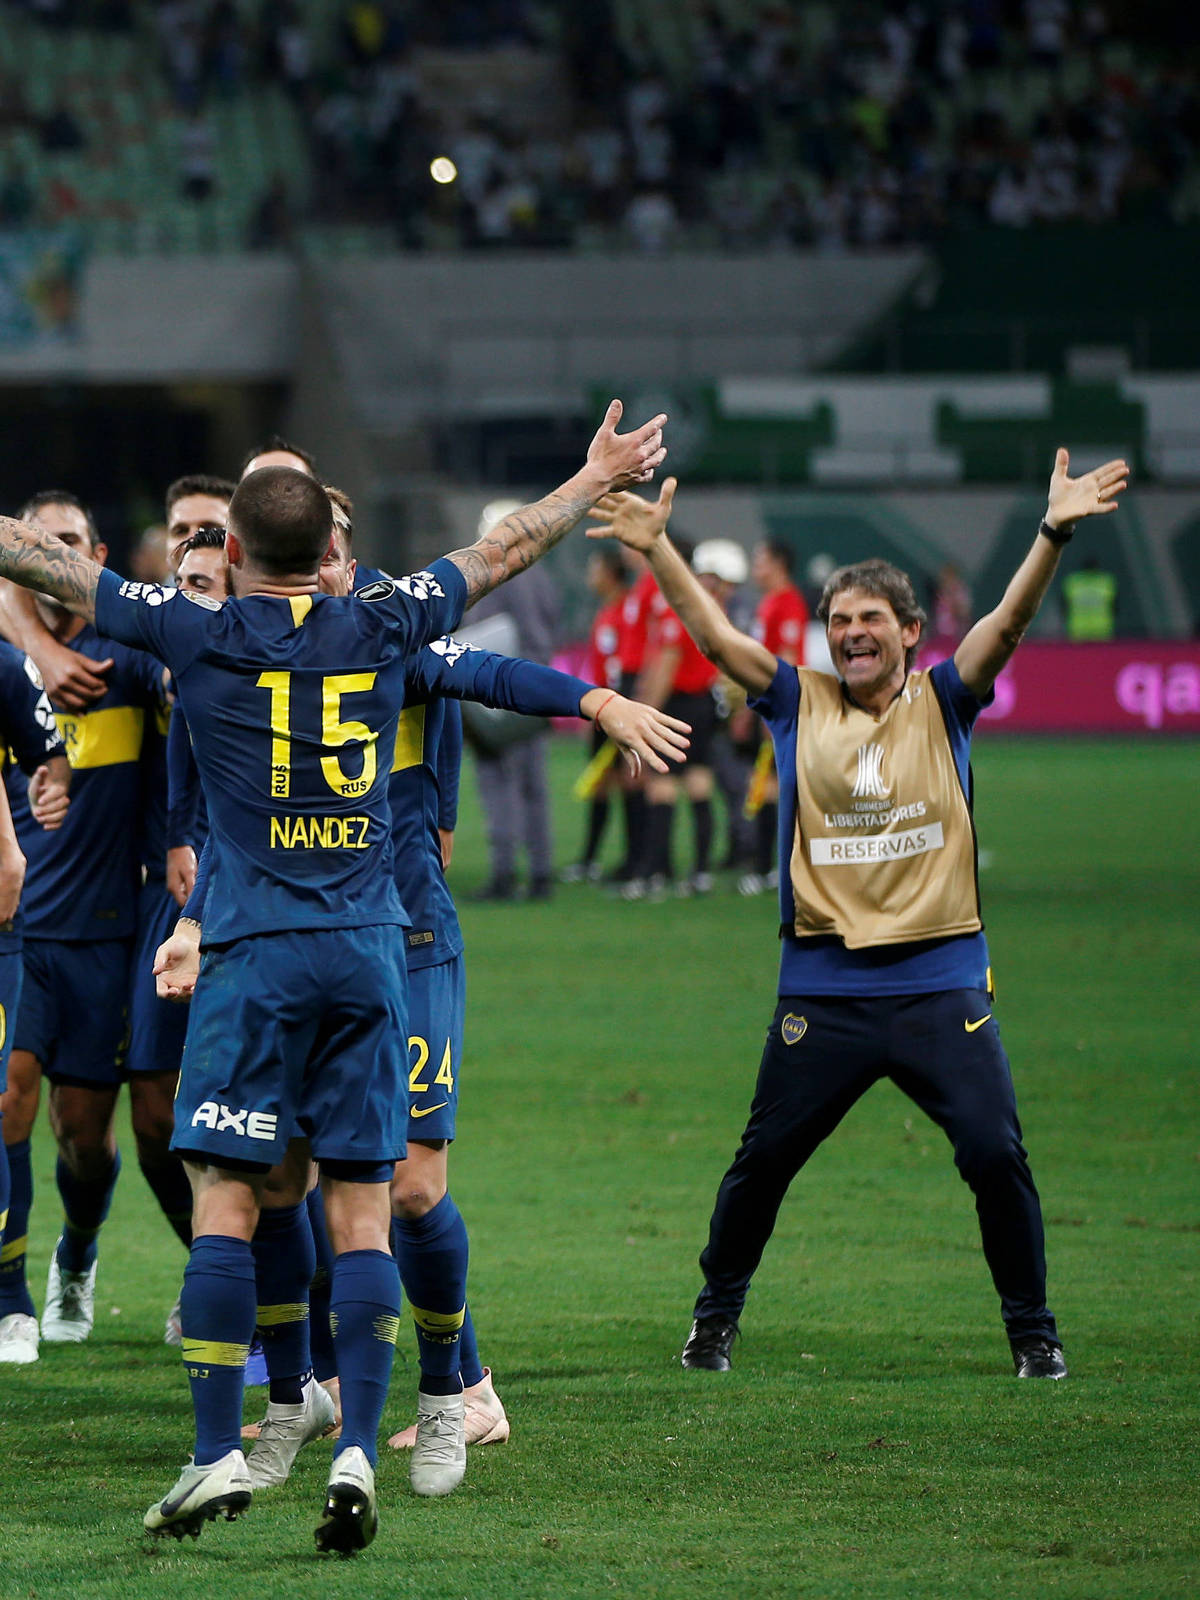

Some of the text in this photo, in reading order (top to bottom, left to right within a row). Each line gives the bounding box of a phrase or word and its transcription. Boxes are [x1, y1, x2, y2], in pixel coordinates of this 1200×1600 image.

[256, 671, 380, 799] 15
[275, 765, 287, 794] RUS
[341, 780, 367, 794] RUS
[824, 801, 927, 828] LIBERTADORES
[270, 816, 371, 850] NANDEZ
[829, 832, 927, 860] RESERVAS
[408, 1035, 454, 1094] 24
[191, 1101, 278, 1141] AXE
